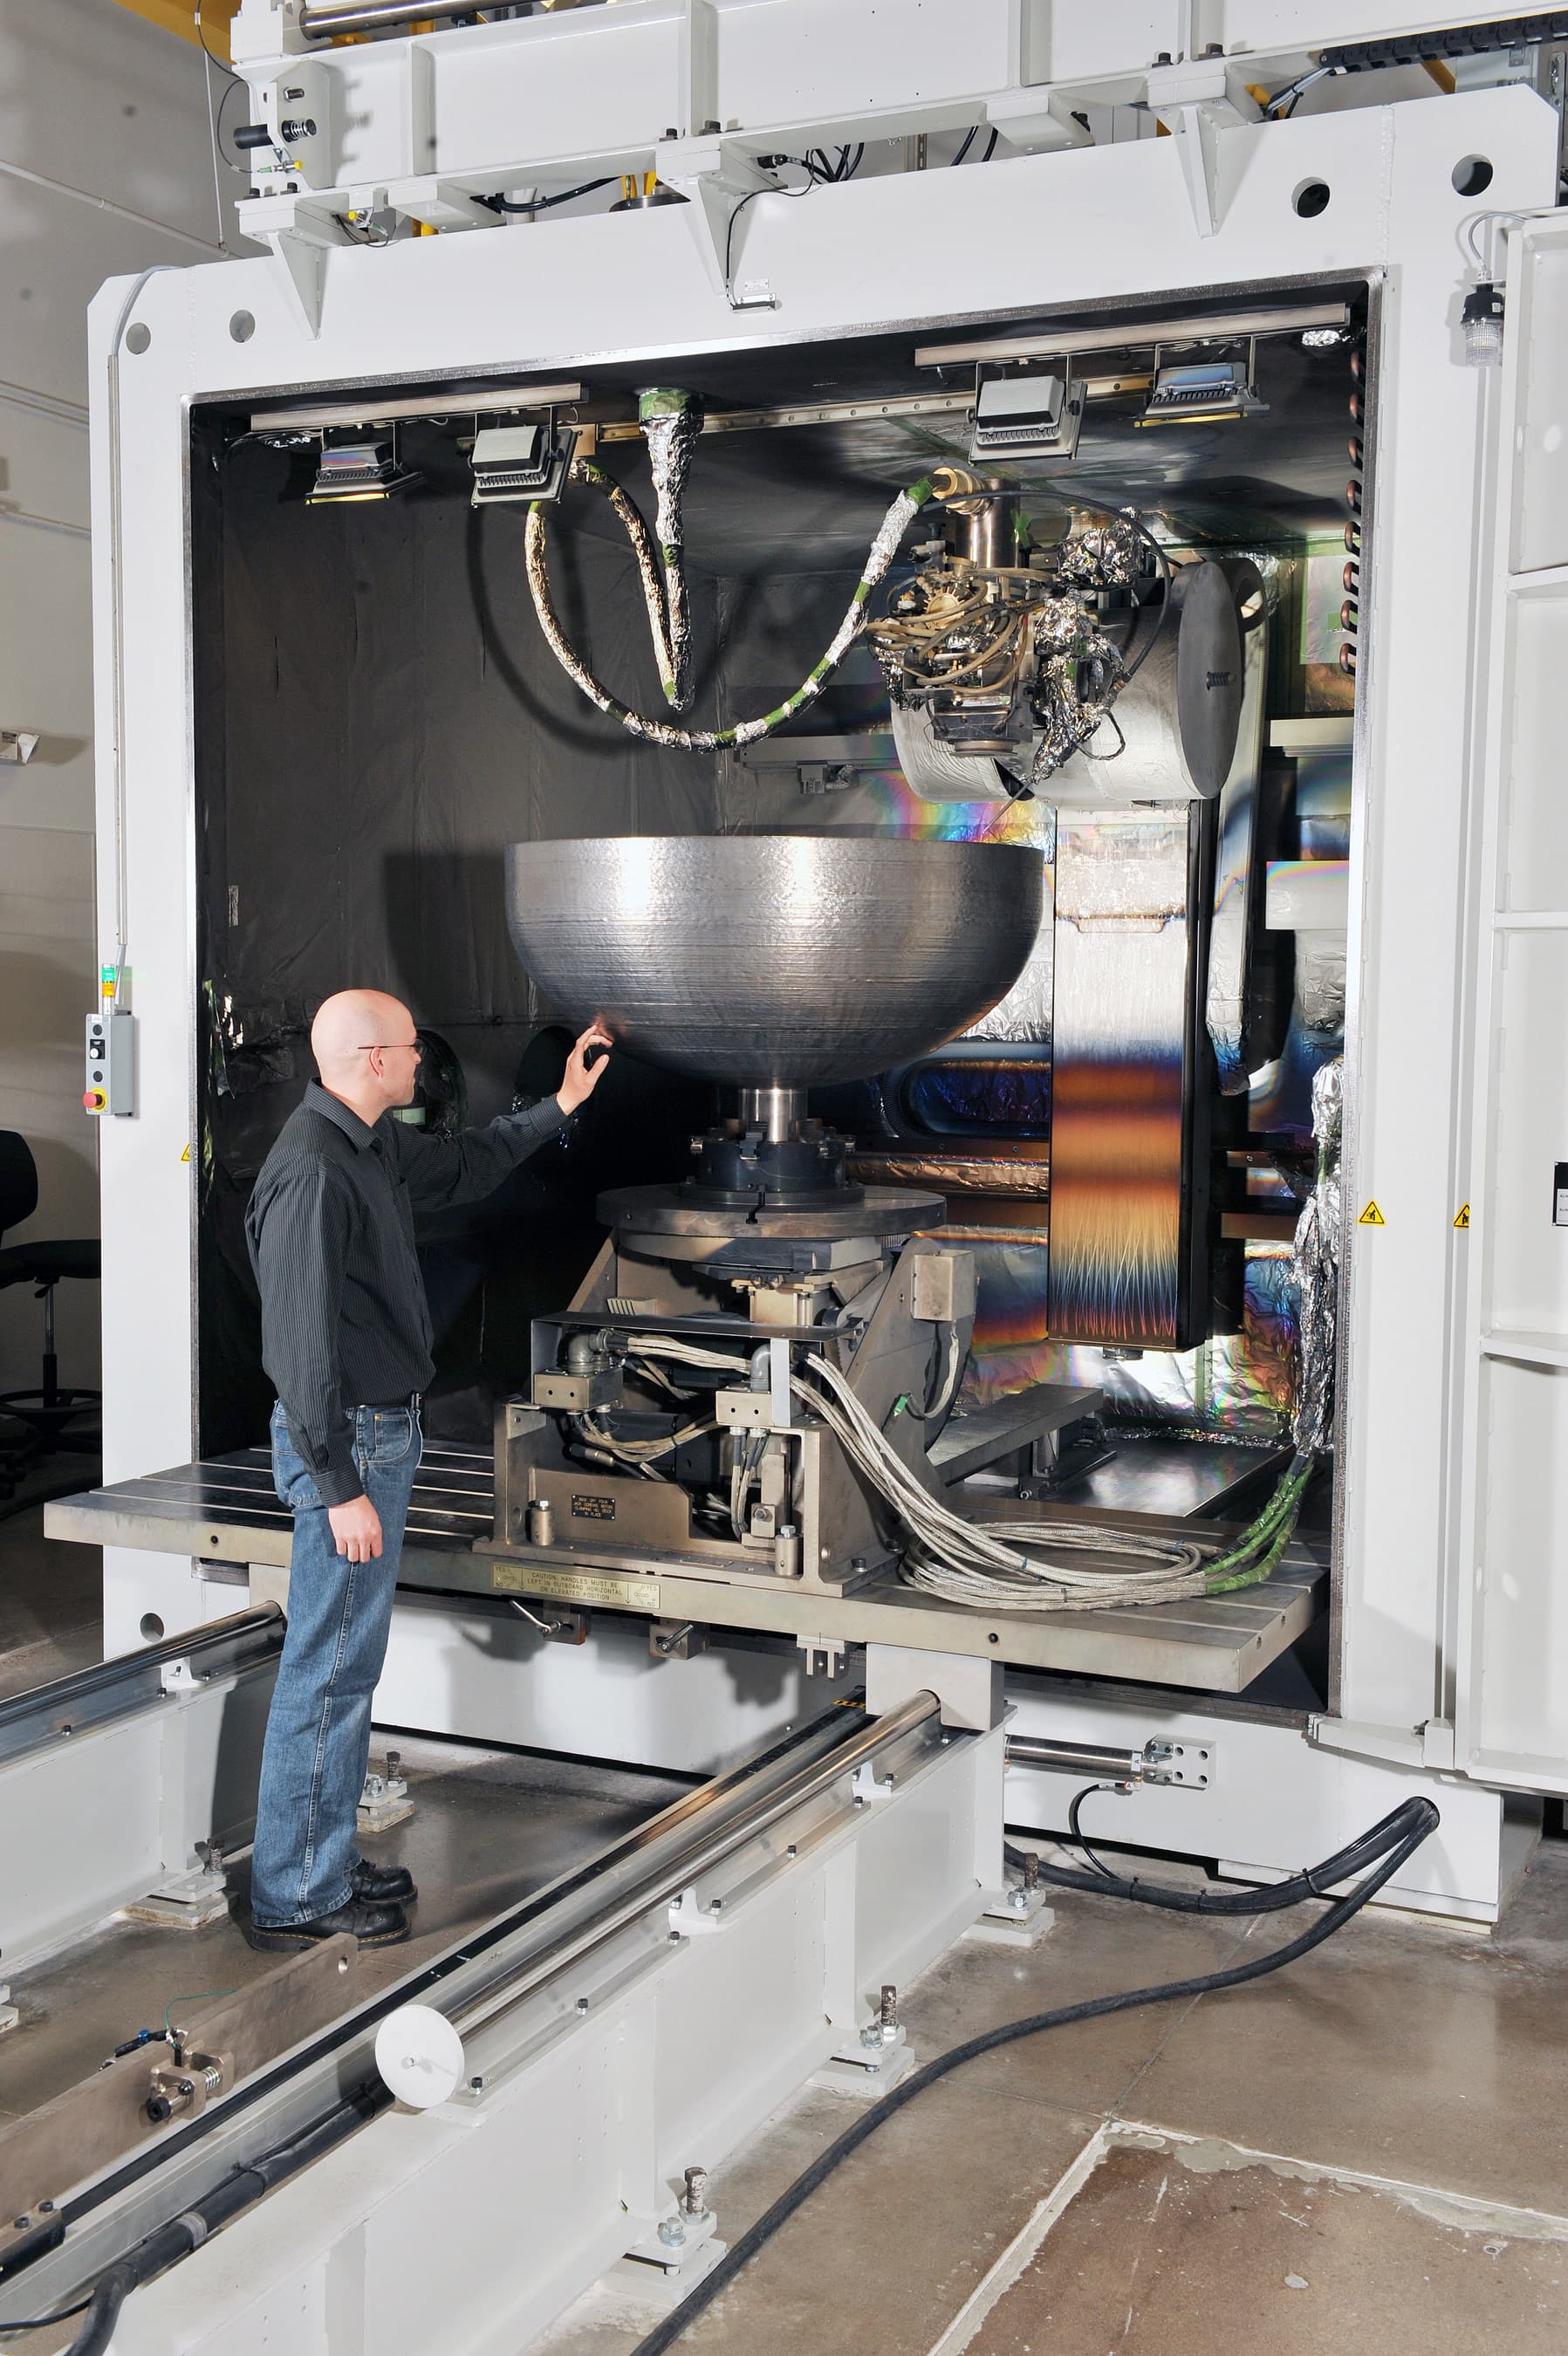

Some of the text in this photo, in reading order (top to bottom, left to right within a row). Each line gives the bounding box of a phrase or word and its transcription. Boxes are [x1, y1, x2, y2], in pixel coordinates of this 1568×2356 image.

[561, 1576, 587, 1585] HANDLES
[551, 1587, 580, 1596] ELEVATED
[553, 1581, 584, 1590] OUTBOARD
[586, 1585, 622, 1596] HORIZONTAL
